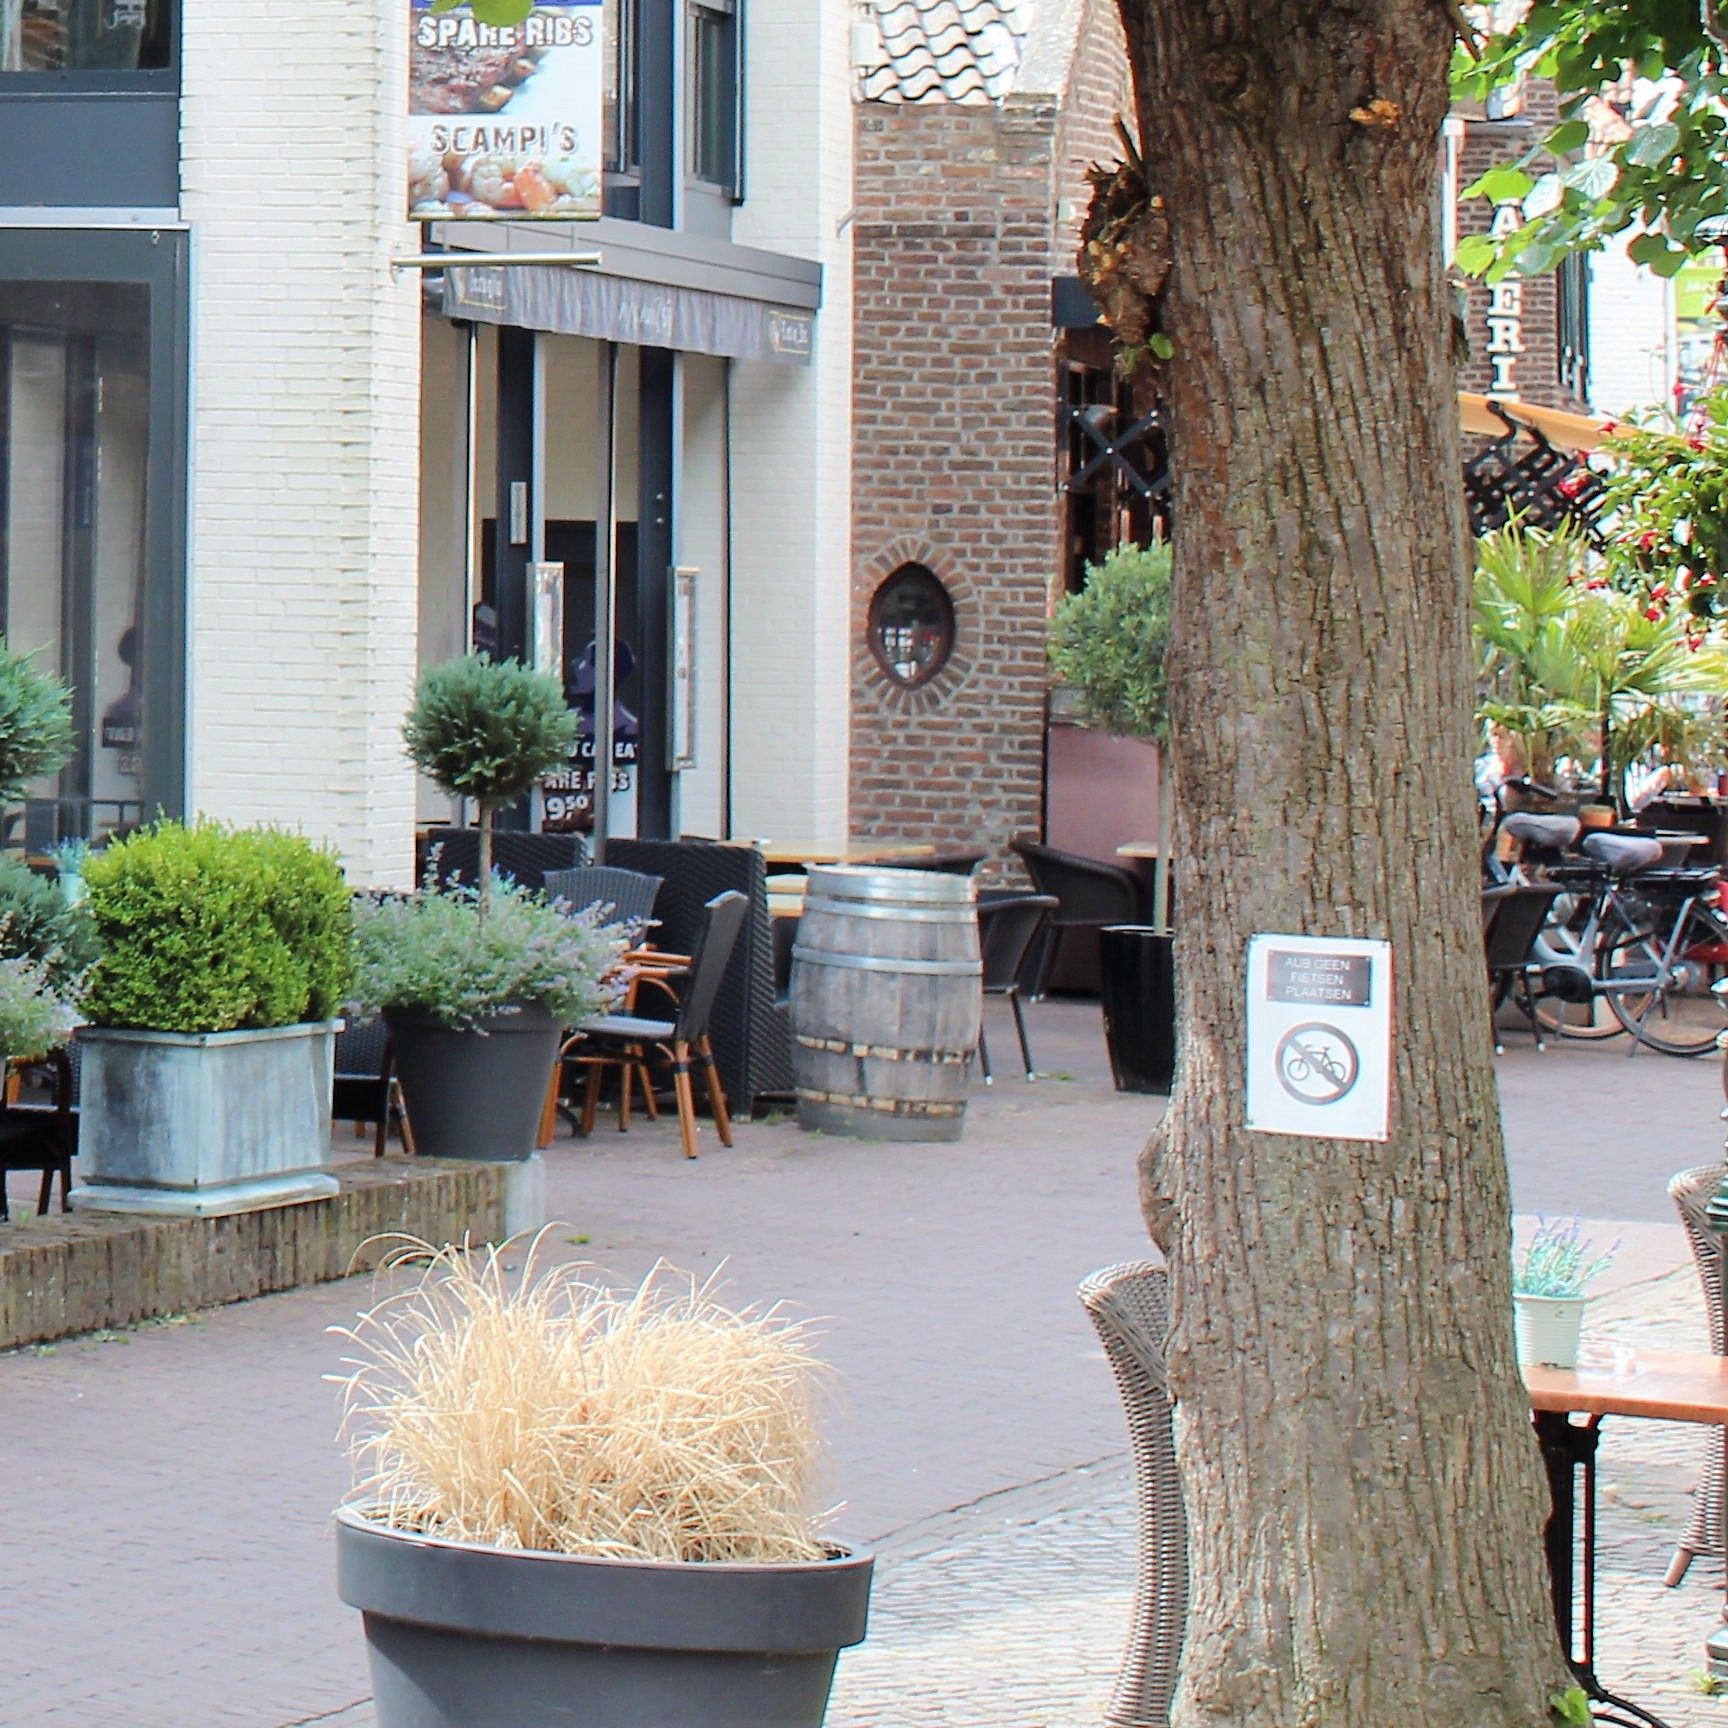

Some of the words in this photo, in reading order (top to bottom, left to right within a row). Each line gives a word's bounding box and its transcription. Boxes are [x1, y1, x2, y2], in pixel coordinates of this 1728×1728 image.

[525, 15, 594, 47] RIBS
[431, 122, 579, 155] SCAMPI'S
[1284, 956, 1312, 969] AUB
[1314, 958, 1351, 971] GEEN
[1290, 971, 1344, 985] FIETSEN
[1285, 985, 1352, 1000] PLAATSEN
